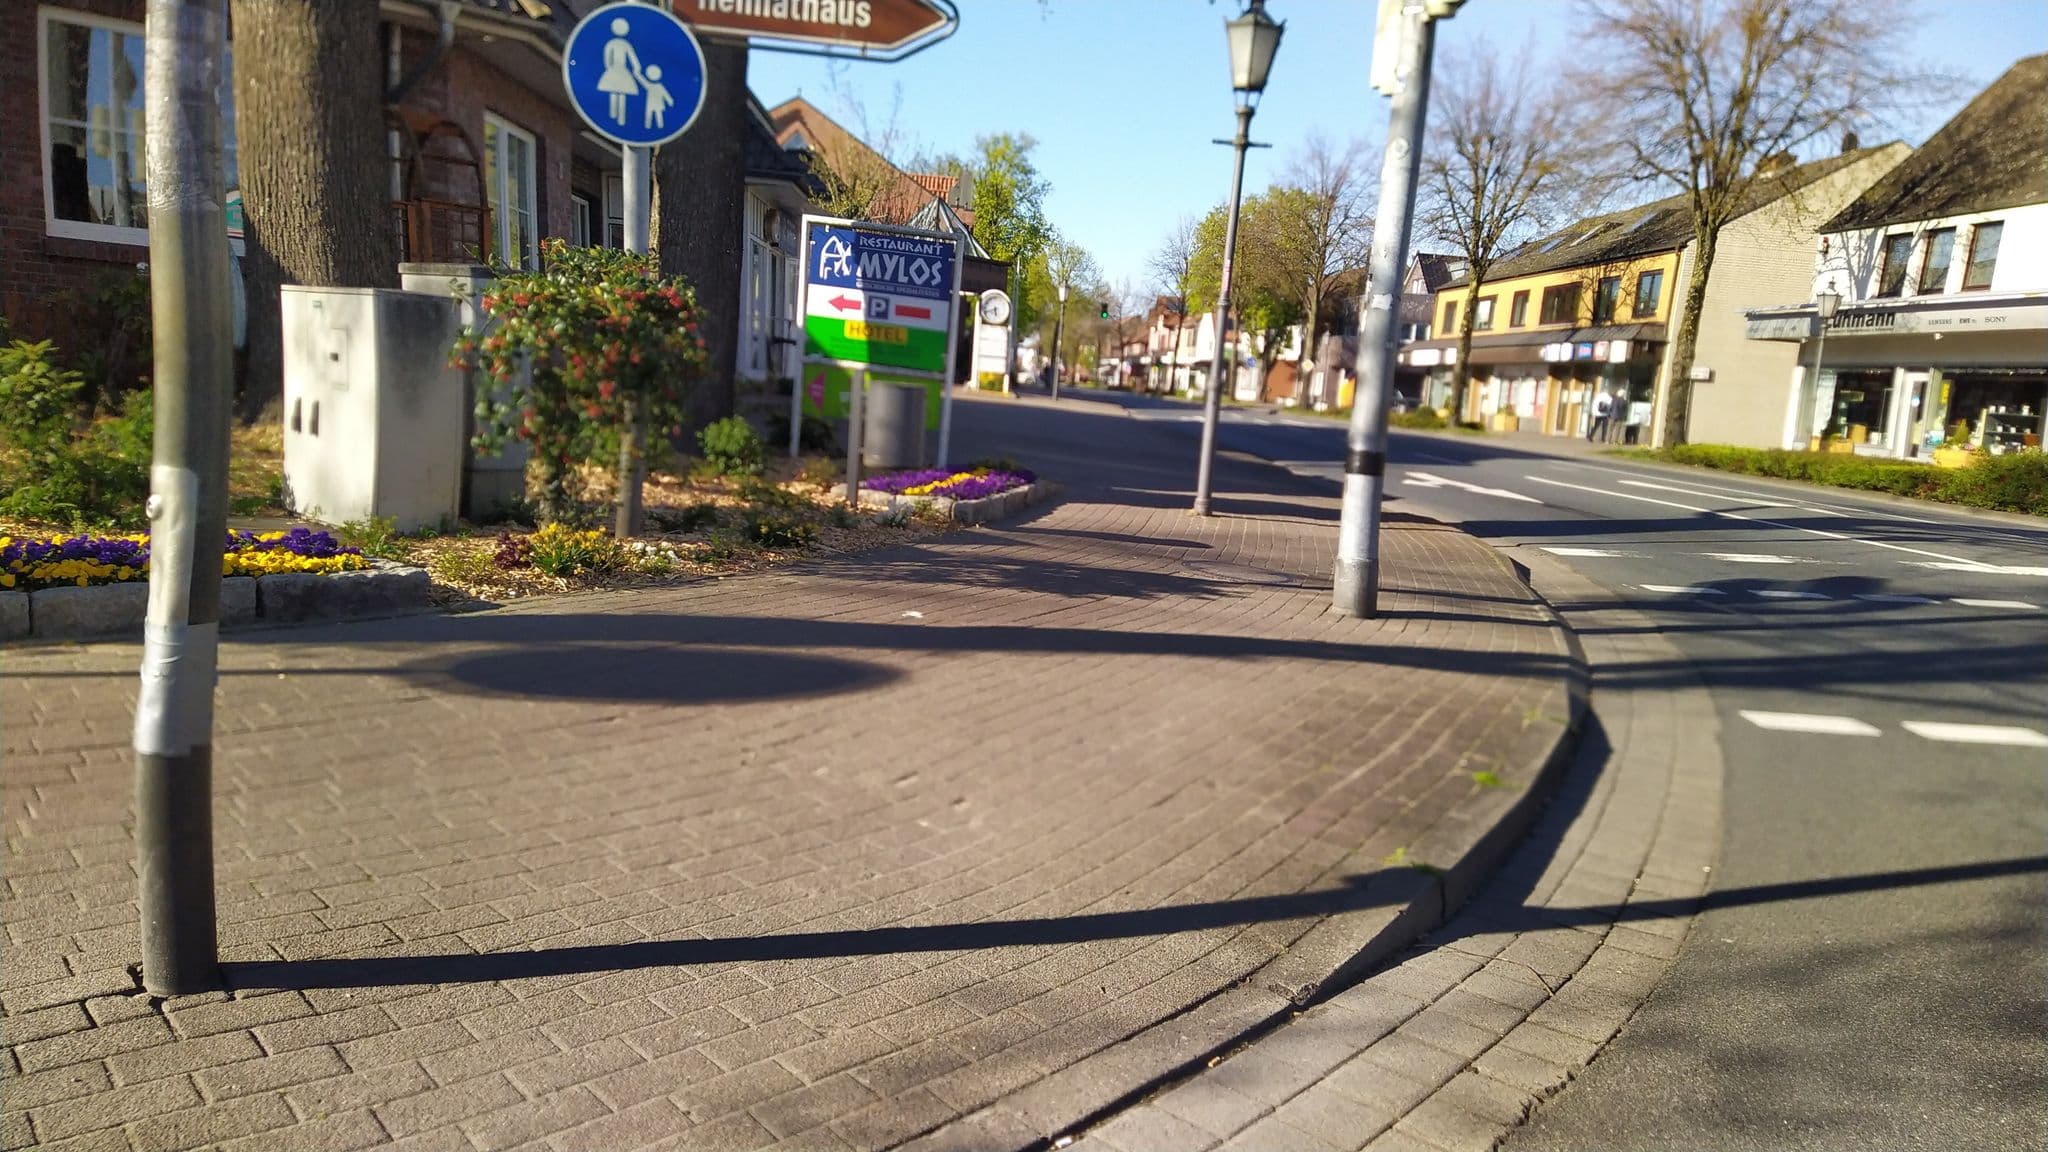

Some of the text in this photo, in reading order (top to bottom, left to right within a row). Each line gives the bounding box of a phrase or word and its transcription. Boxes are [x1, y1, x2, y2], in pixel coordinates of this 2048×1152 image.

[698, 0, 872, 28] eimathaus
[860, 236, 943, 256] RESTAURANT
[856, 251, 943, 286] MYLOS
[870, 298, 887, 317] P
[1984, 315, 2008, 324] SONY
[848, 322, 906, 343] HOTEL
